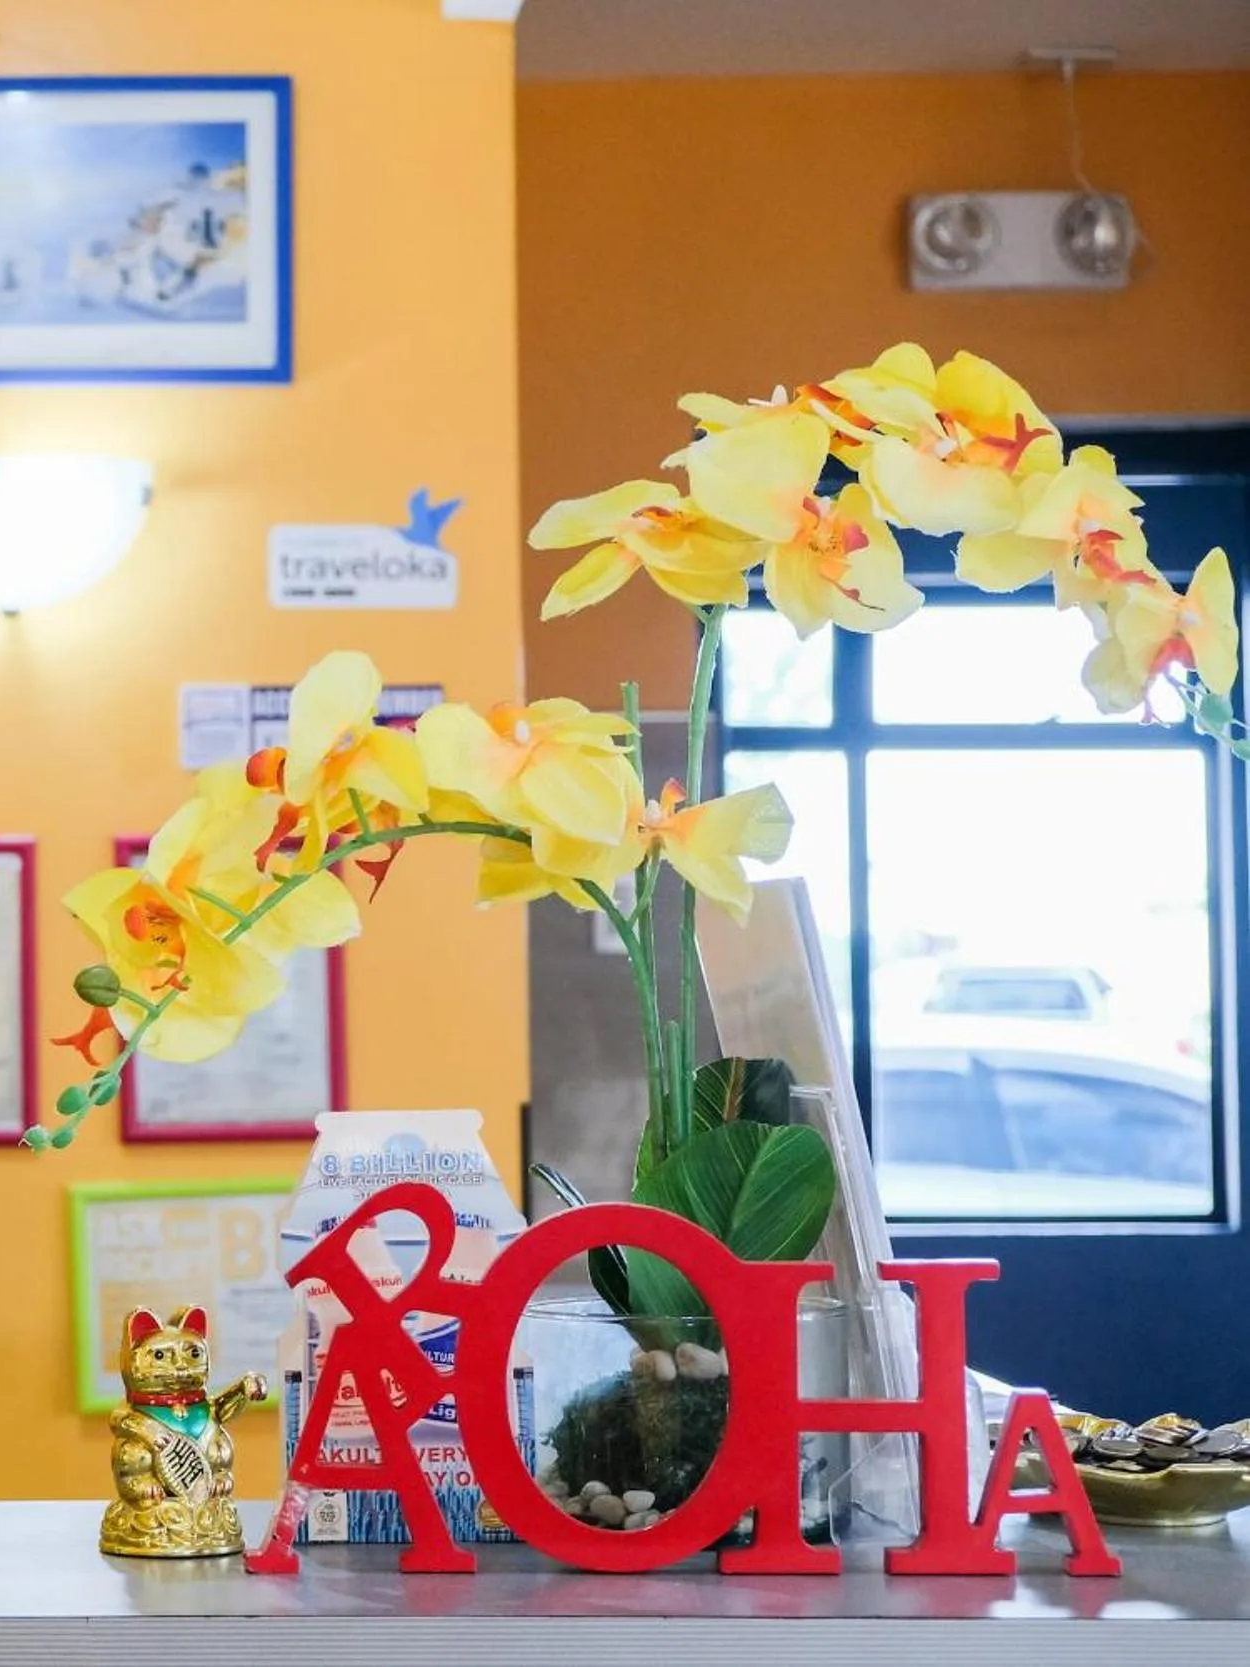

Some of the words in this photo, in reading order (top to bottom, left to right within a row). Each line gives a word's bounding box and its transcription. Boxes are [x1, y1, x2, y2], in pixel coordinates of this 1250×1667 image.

[280, 549, 447, 582] traveloka
[321, 1153, 340, 1176] 8
[349, 1151, 485, 1175] BILLION
[427, 1404, 456, 1419] Lig
[320, 1448, 382, 1463] AKUL
[418, 1446, 467, 1462] VERY
